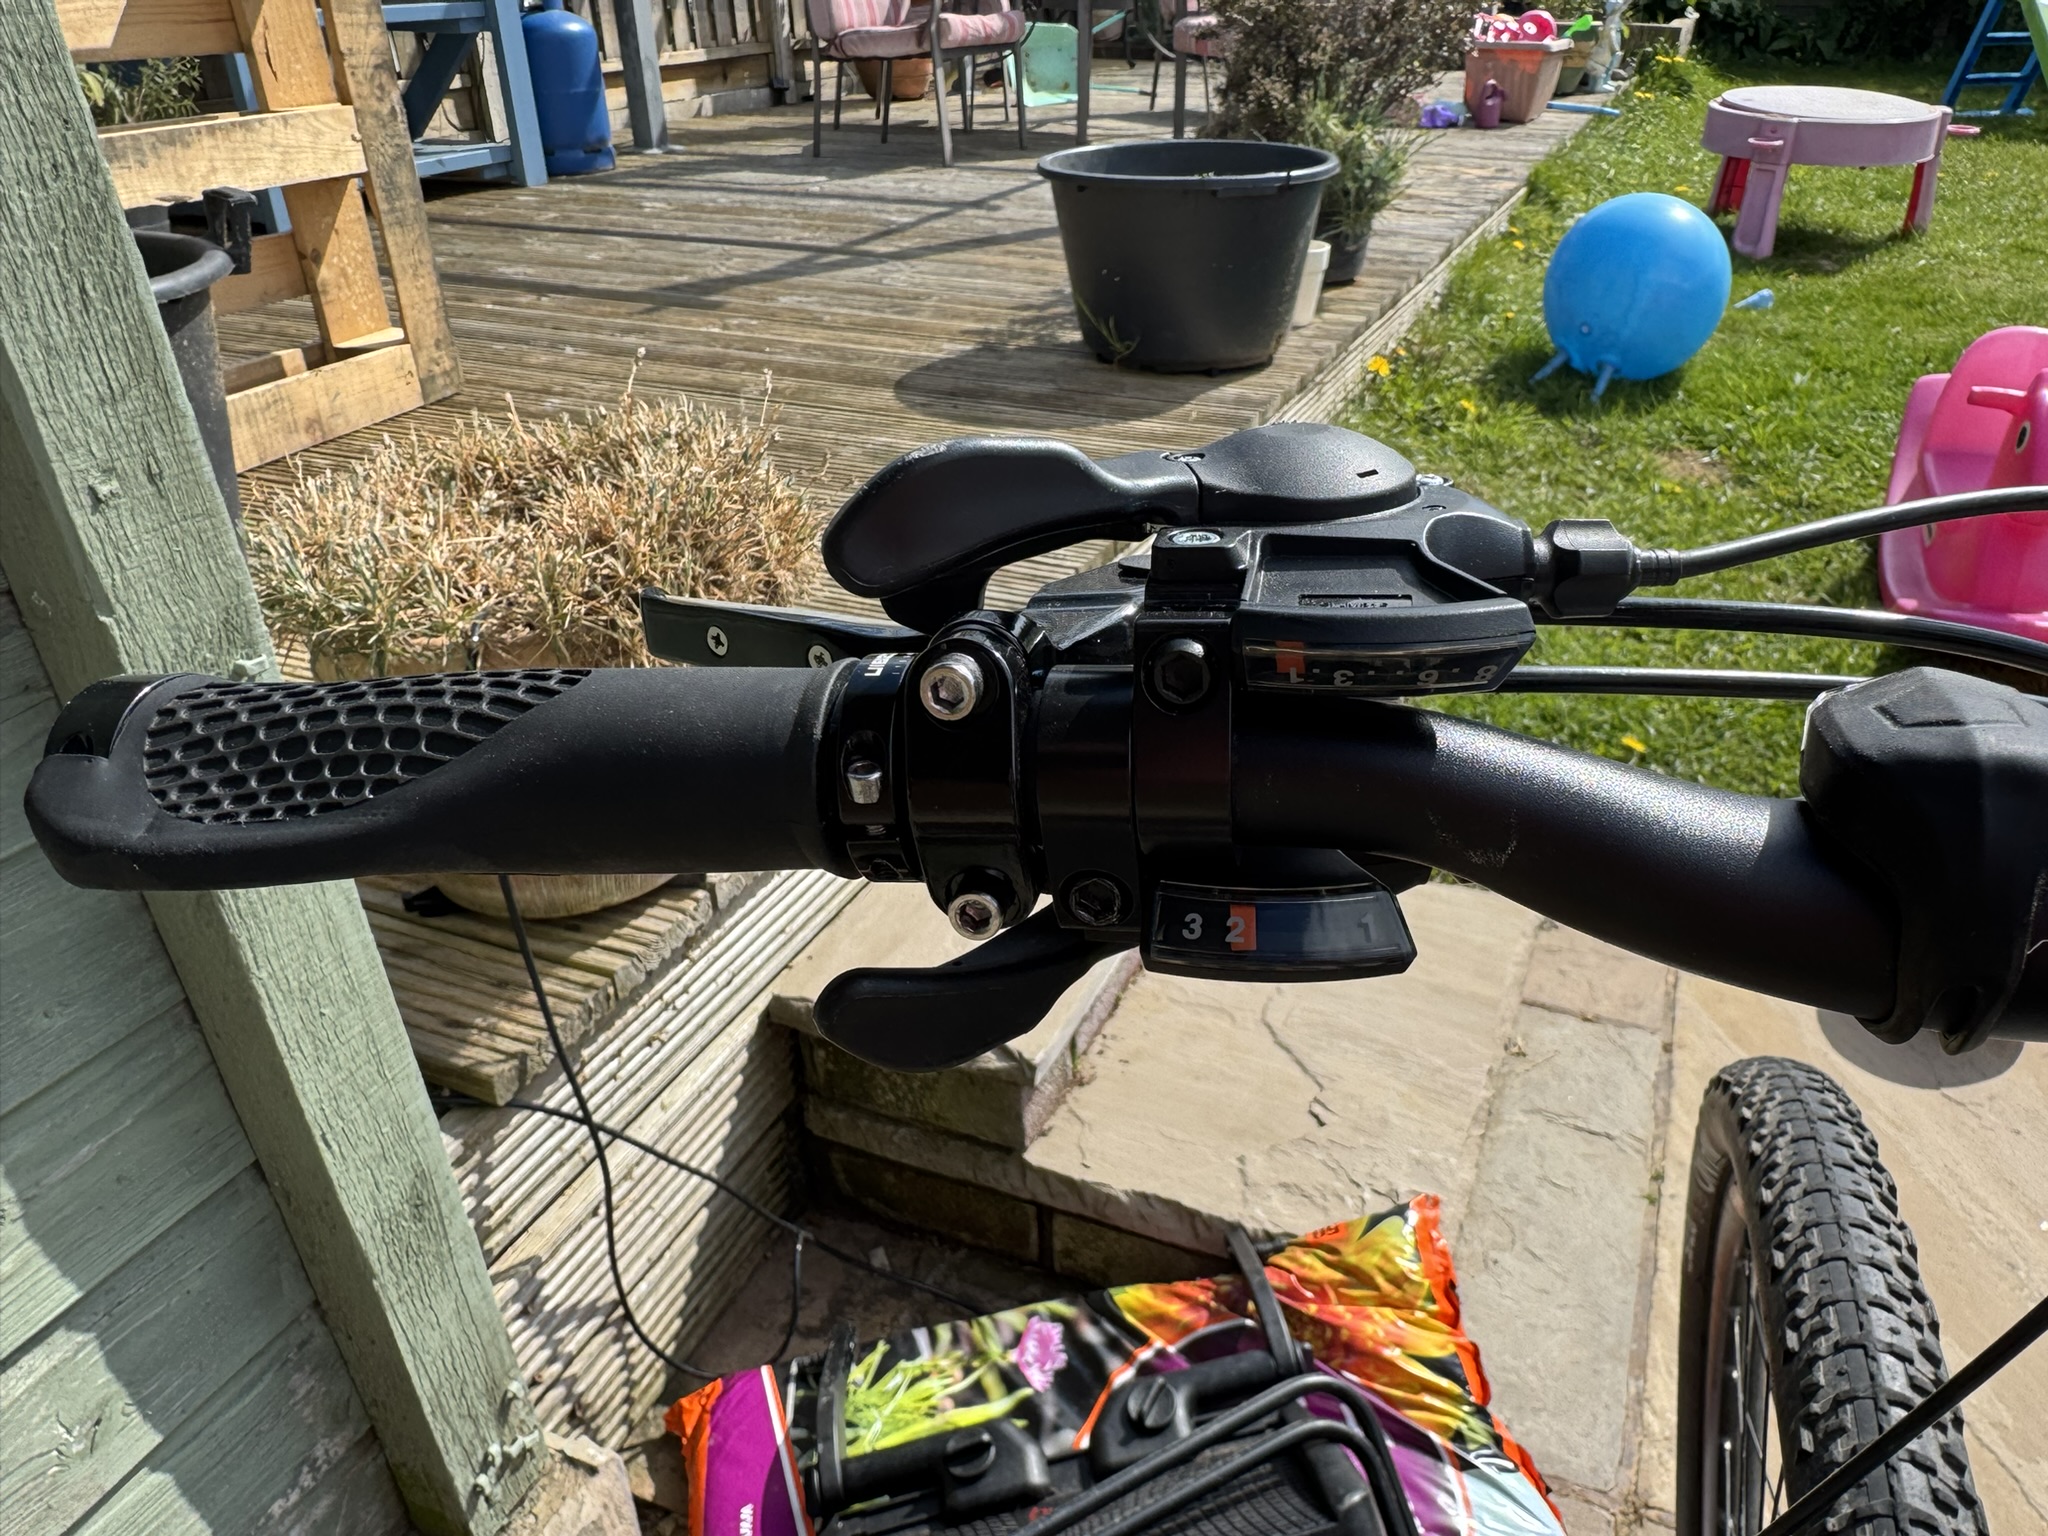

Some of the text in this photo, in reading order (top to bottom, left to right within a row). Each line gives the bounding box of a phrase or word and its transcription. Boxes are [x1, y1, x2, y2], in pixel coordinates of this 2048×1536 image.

[1289, 667, 1305, 684] 1
[1333, 669, 1355, 686] 3
[1473, 665, 1499, 682] 8
[1181, 911, 1375, 943] 3 2 1
